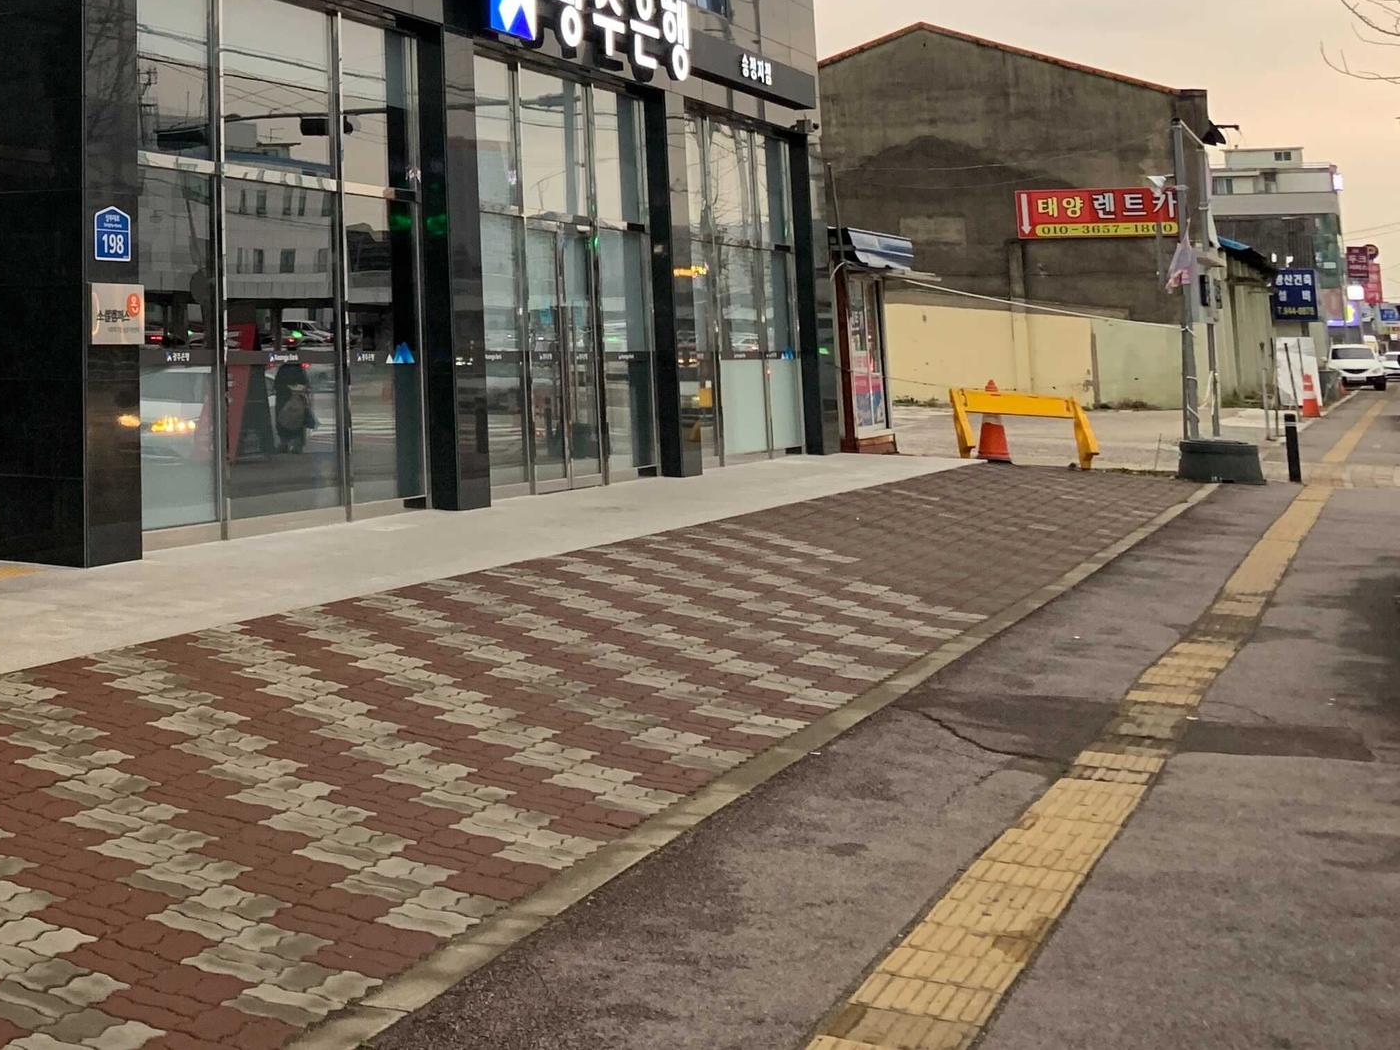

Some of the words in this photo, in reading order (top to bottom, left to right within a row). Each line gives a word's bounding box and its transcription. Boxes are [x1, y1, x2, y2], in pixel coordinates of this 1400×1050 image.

[741, 53, 772, 86] 송정지점
[1037, 196, 1084, 218] 태양
[1092, 191, 1177, 219] 렌트카
[102, 234, 124, 254] 198
